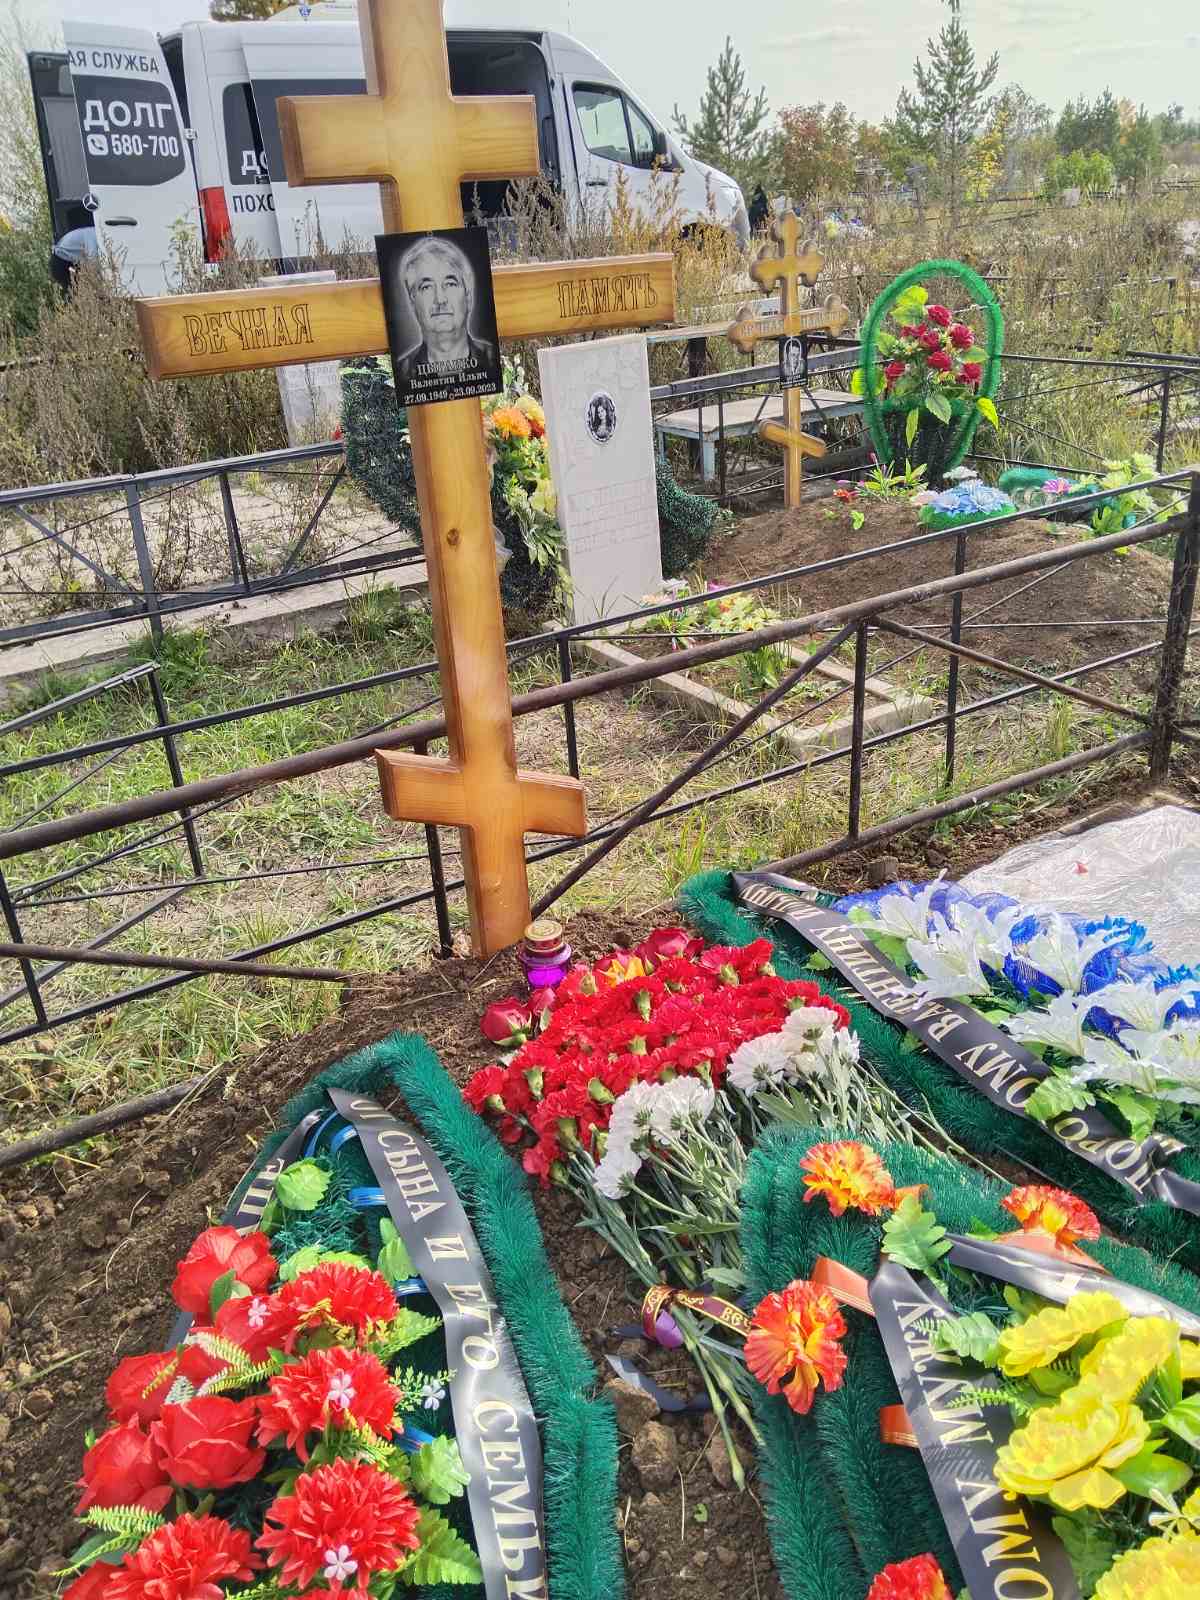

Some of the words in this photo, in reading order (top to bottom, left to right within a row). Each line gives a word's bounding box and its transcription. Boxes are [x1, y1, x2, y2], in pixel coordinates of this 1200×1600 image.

[92, 51, 160, 74] СЛУЖБА
[84, 100, 172, 132] ДОЛГ
[111, 134, 180, 157] 580-700
[183, 304, 315, 356] ВЕЧНАЯ
[557, 273, 659, 318] ПАМЯТЬ
[956, 1042, 1162, 1195] ДОРООМУ
[377, 1130, 448, 1223] СЫНА
[424, 1234, 469, 1263] И
[444, 1282, 500, 1370] ЕГО
